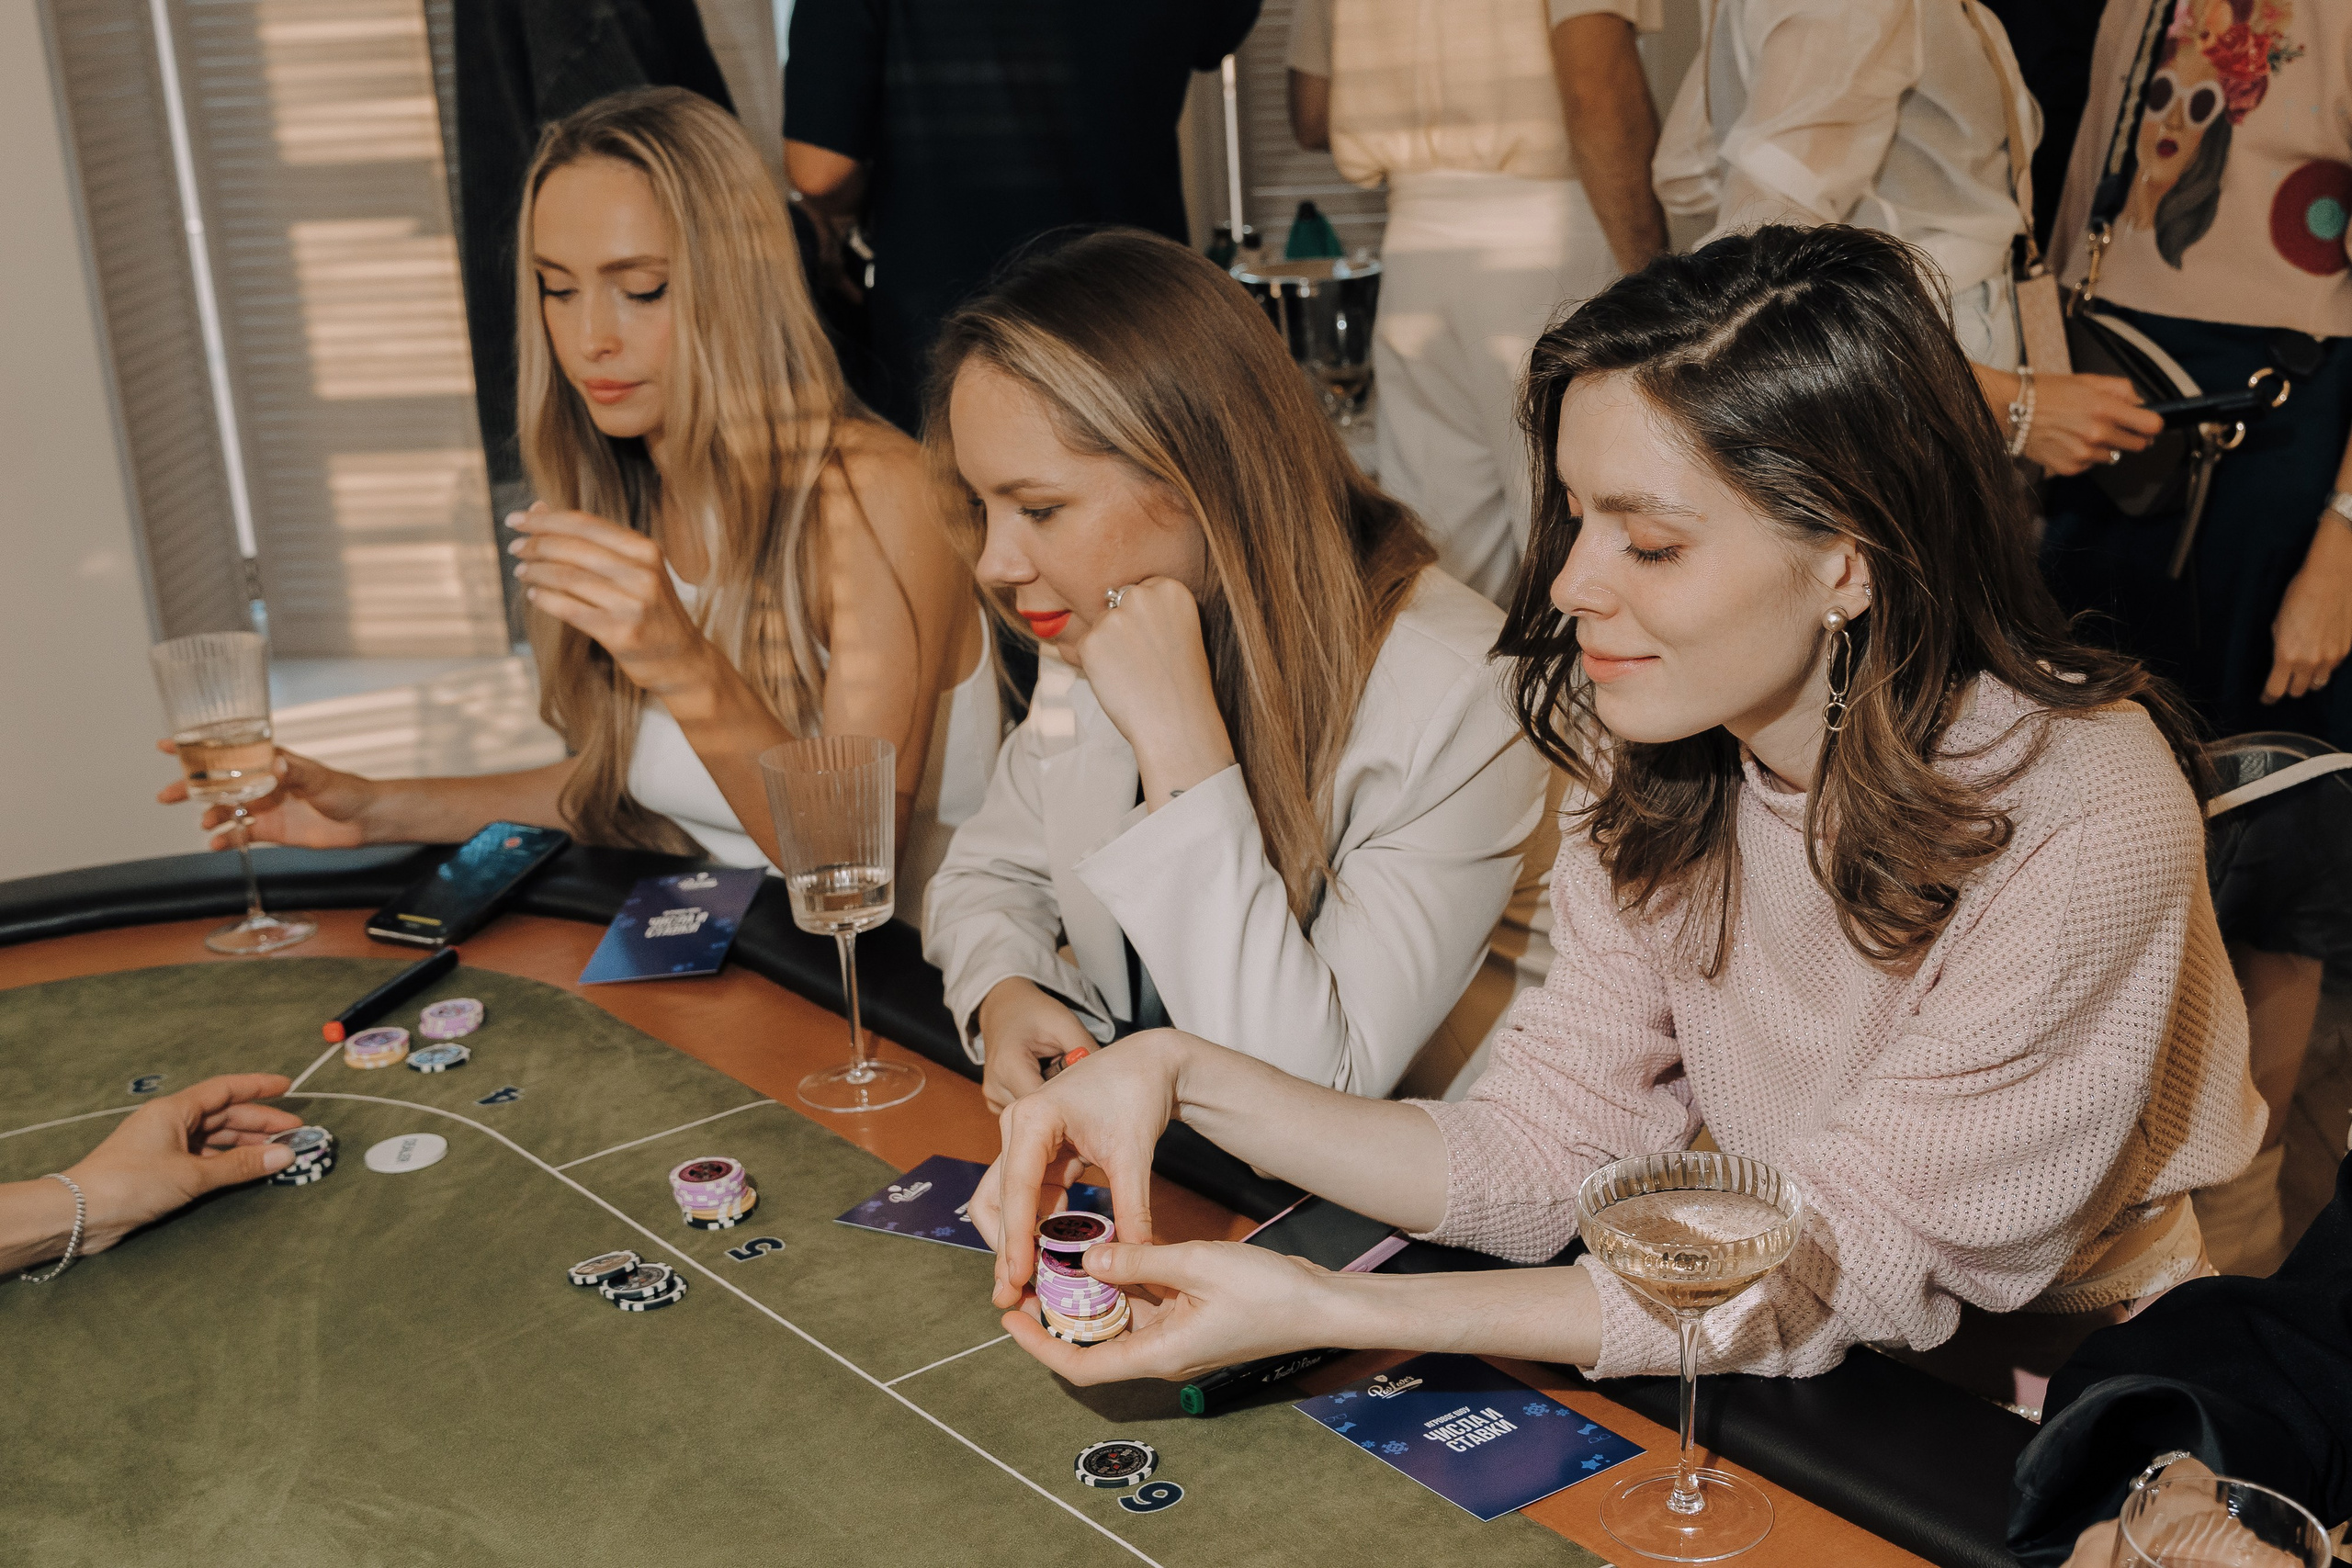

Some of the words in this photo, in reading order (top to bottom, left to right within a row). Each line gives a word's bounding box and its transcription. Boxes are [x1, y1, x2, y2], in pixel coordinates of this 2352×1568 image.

[129, 1074, 166, 1095] 3
[475, 1086, 525, 1105] 4
[724, 1236, 786, 1263] 5
[1423, 1414, 1490, 1442] ЧИСЛА
[1479, 1407, 1504, 1421] И
[1424, 1413, 1457, 1428] ИГРОВОЕ
[1452, 1405, 1471, 1416] ШОУ
[1445, 1418, 1518, 1452] СТАВКИ
[1117, 1480, 1184, 1514] 6
